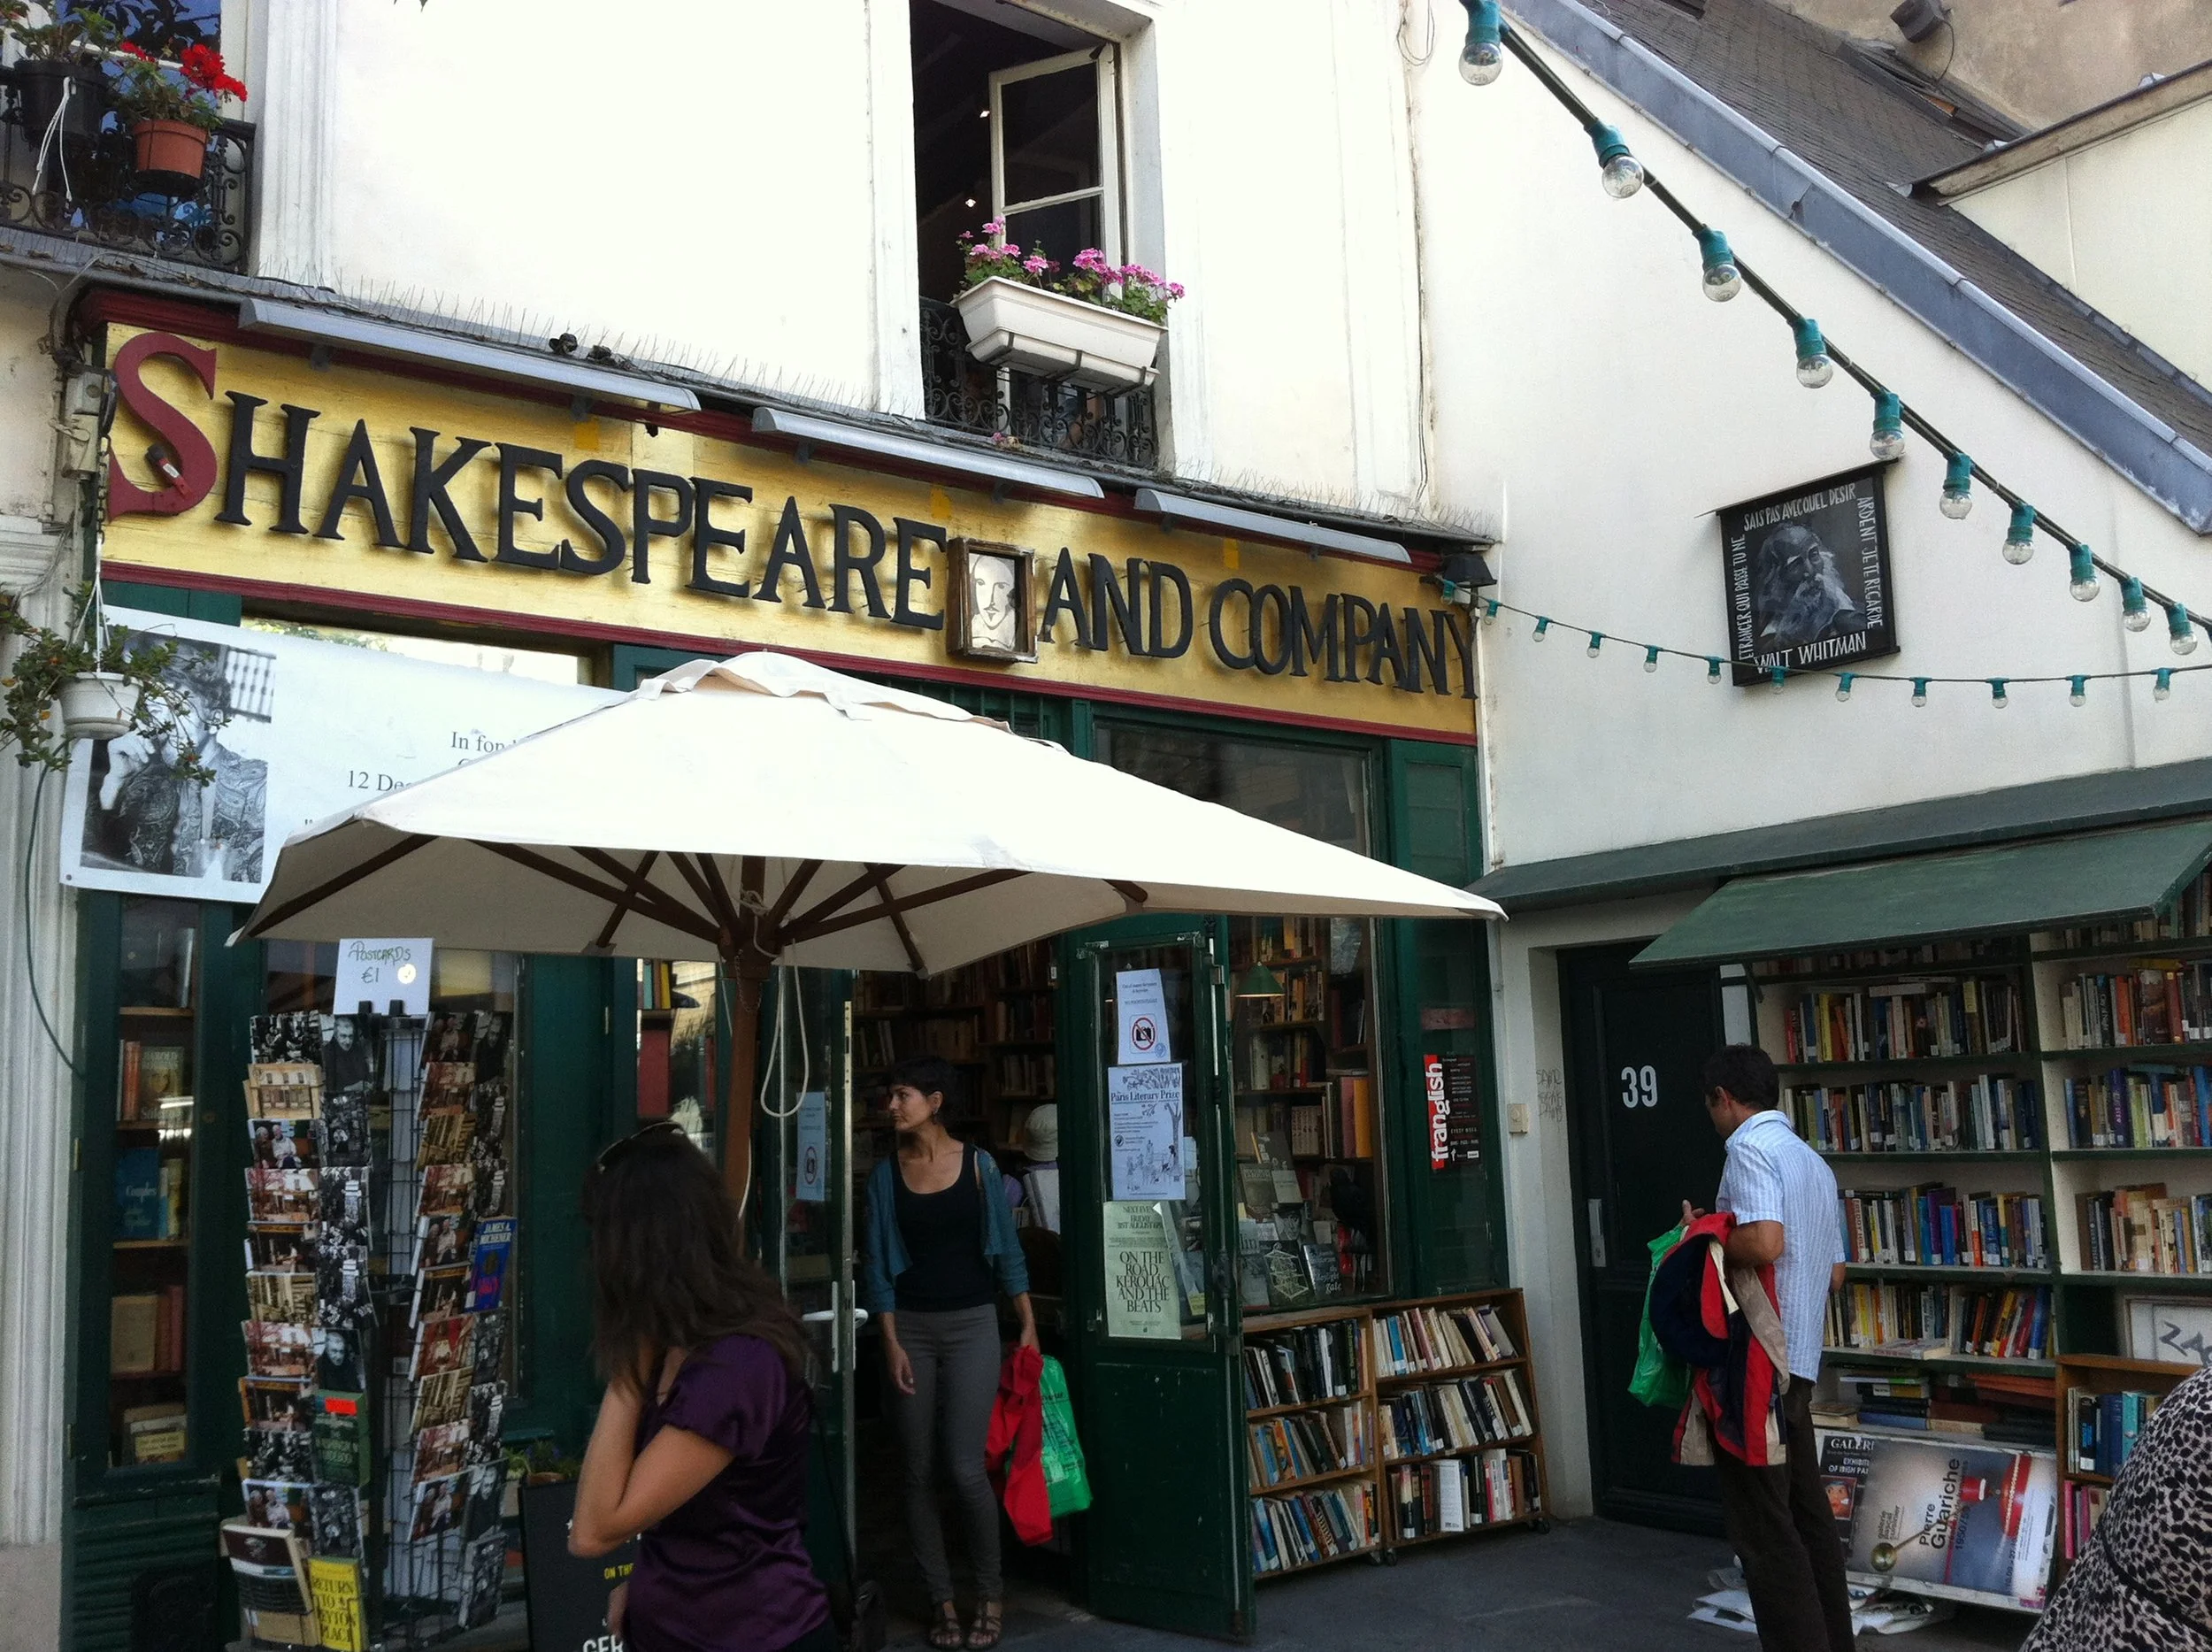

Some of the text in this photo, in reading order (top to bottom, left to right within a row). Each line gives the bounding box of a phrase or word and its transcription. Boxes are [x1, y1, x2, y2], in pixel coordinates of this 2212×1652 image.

[108, 330, 1479, 699] SHAKESPEARE AND COMPANY
[1743, 482, 1856, 531] SAIS PAS AVEC QUEL DESIR
[1731, 534, 1746, 551] NE
[1732, 551, 1747, 567] TU
[1856, 496, 1883, 629] ARDENT JE TE REGARDE
[1735, 591, 1750, 611] QUI
[1797, 630, 1866, 665] WHITMAN
[450, 731, 469, 749] In
[347, 770, 369, 789] 12
[361, 966, 379, 984] €1
[1110, 1089, 1180, 1102] Paris Literary Prize
[1621, 1065, 1659, 1110] 39
[1425, 1063, 1451, 1162] franglish
[1119, 1251, 1164, 1264] ON THE
[1116, 1275, 1170, 1289] KEROUAC
[1118, 1287, 1170, 1301] AND THE
[1127, 1300, 1162, 1313] BEATS
[1931, 1458, 1960, 1549] Guariche
[1919, 1503, 1936, 1547] Pierre
